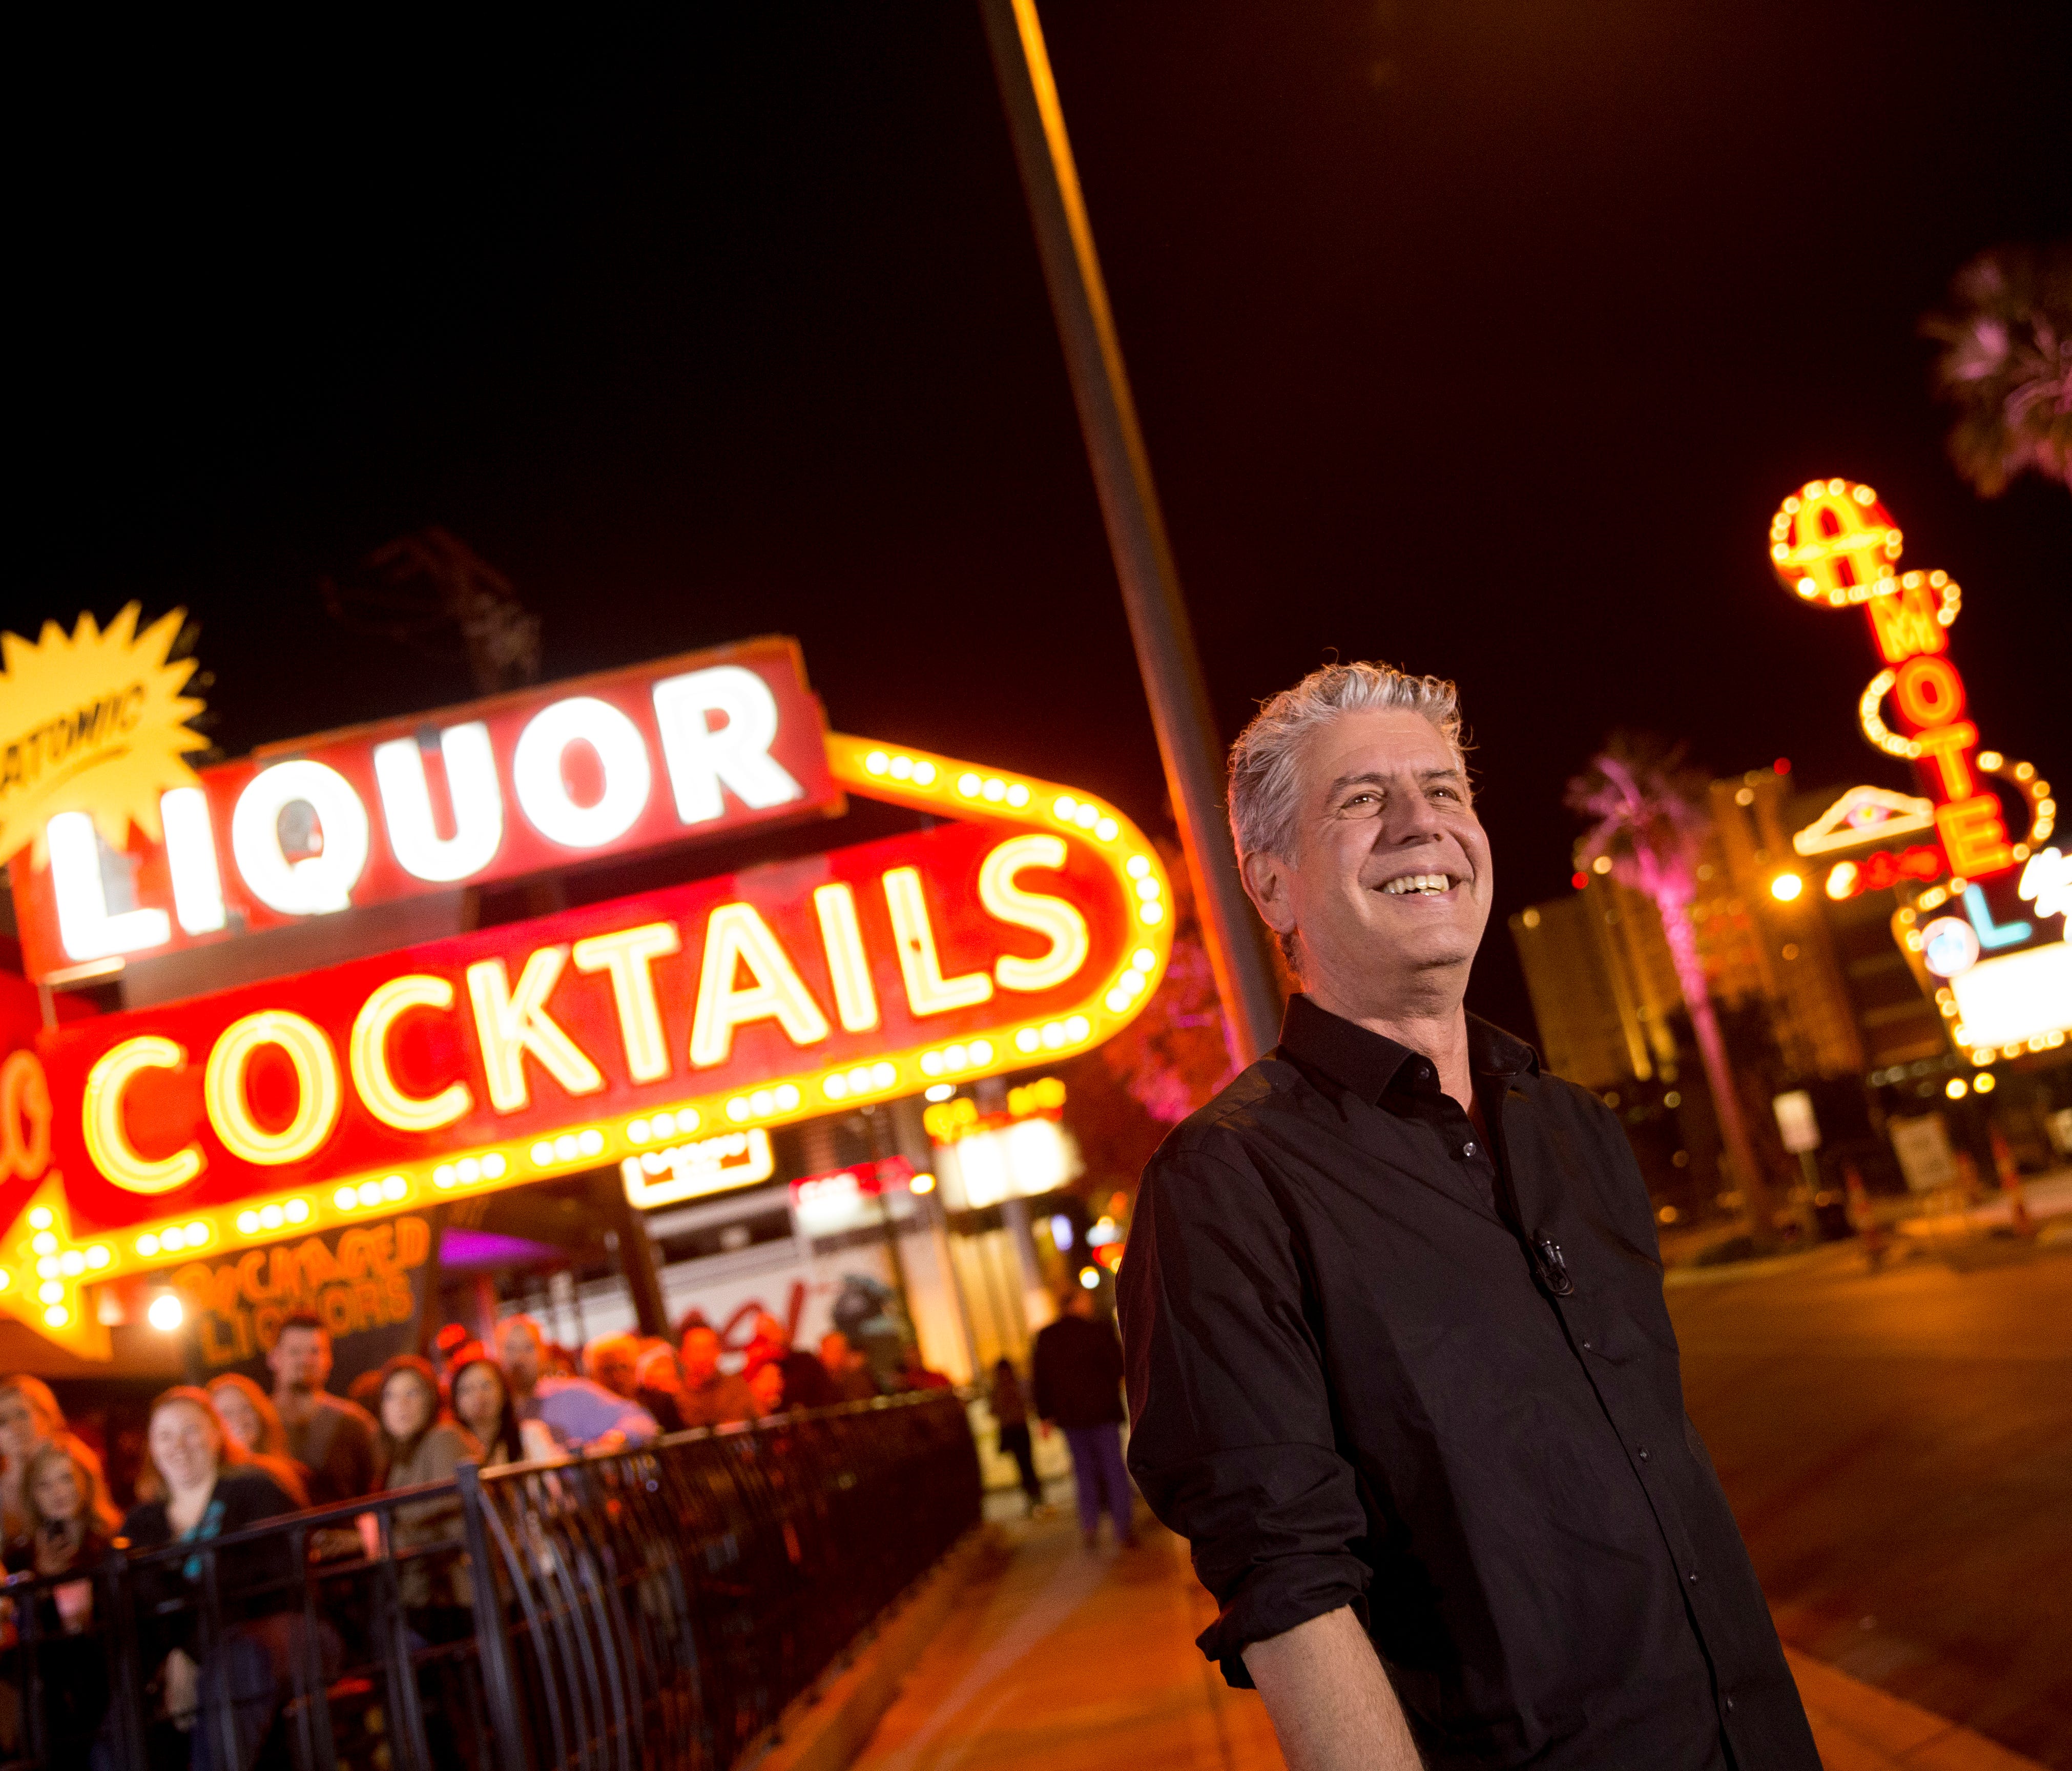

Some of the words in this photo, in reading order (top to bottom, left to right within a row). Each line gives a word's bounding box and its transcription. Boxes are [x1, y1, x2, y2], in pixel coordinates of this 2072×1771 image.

[0, 683, 146, 794] ATOMIC
[47, 664, 806, 962] LIQUOR
[1865, 576, 2033, 948] MOTEL
[81, 833, 1089, 1195] COCKTAILS
[200, 1273, 414, 1367] LIQORS
